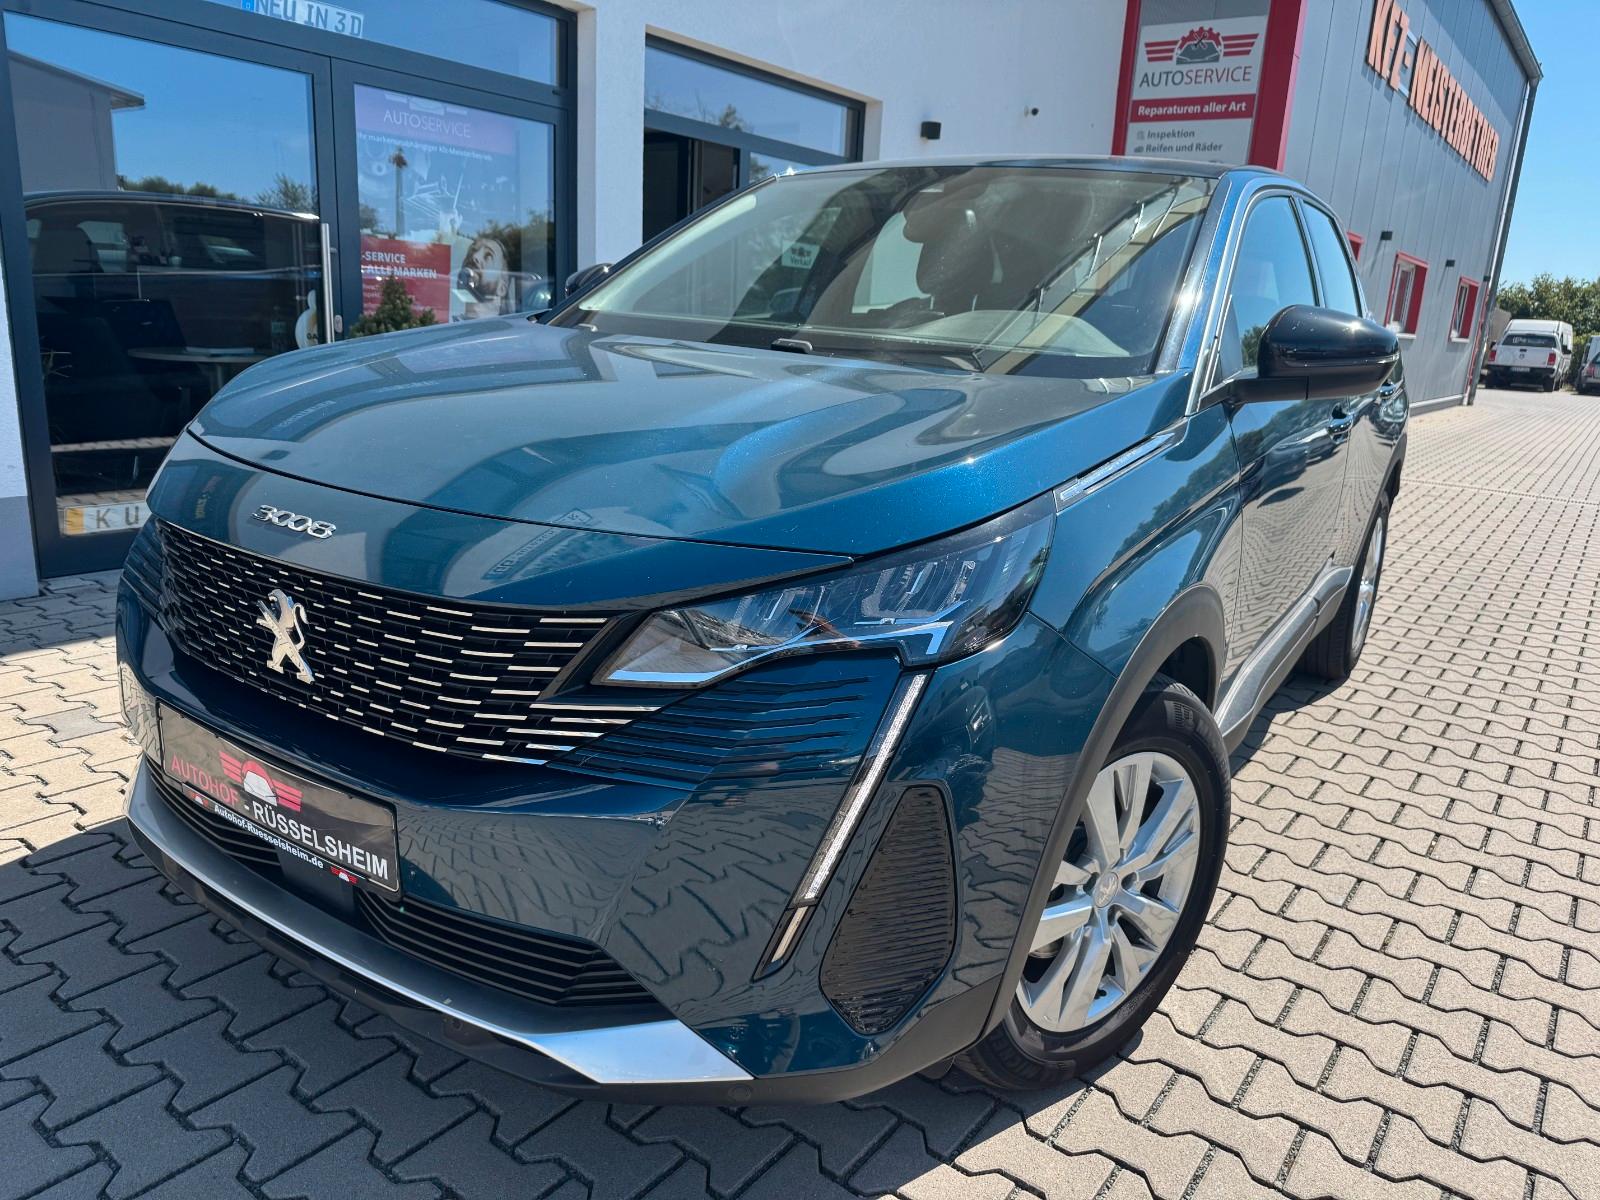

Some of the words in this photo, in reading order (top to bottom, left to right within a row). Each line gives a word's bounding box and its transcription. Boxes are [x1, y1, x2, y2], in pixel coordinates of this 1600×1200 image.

[256, 0, 296, 21] NEU
[304, 4, 328, 29] IN
[1139, 66, 1253, 88] AUTOSERVICE
[1138, 103, 1201, 117] Reparaturen
[1202, 102, 1227, 113] aller
[1229, 101, 1247, 112] Art
[383, 109, 472, 138] AUTOSERVICE
[1147, 129, 1195, 141] Inspektion
[1145, 143, 1173, 153] Reifen
[1175, 143, 1193, 152] und
[1195, 141, 1223, 152] Räder
[393, 266, 437, 279] MARKEN
[250, 504, 337, 539] 3008
[171, 754, 240, 808] AUTOHOF
[252, 799, 389, 881] RÜSSELSHEIM
[213, 803, 325, 870] Autohof-Ruesselsheim.de
